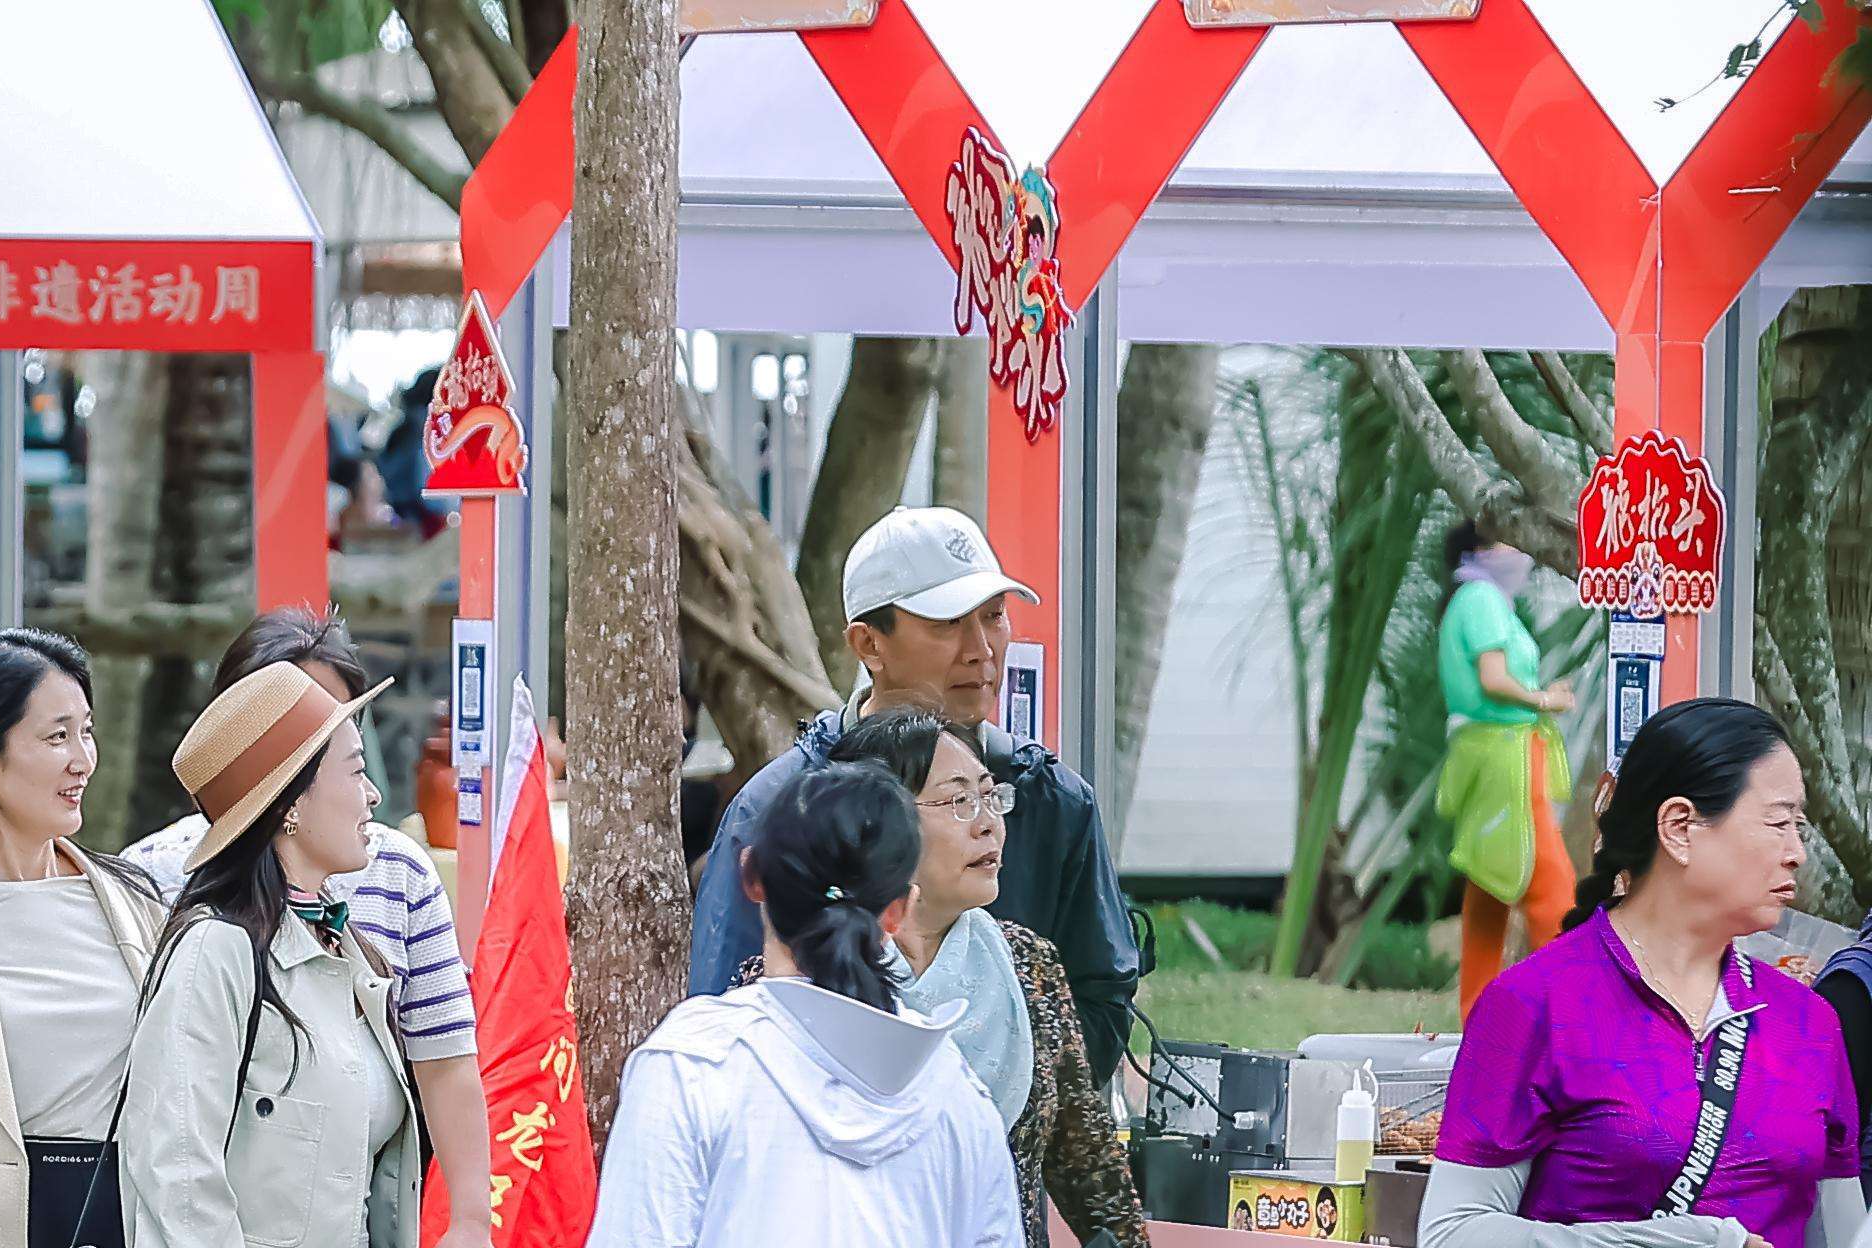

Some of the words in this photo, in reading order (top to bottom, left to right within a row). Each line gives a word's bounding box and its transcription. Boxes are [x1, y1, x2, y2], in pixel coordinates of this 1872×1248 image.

[1691, 1100, 1716, 1159] LIMITED
[1699, 1106, 1729, 1165] EDITION
[1257, 1195, 1310, 1228] 章鱼小丸子
